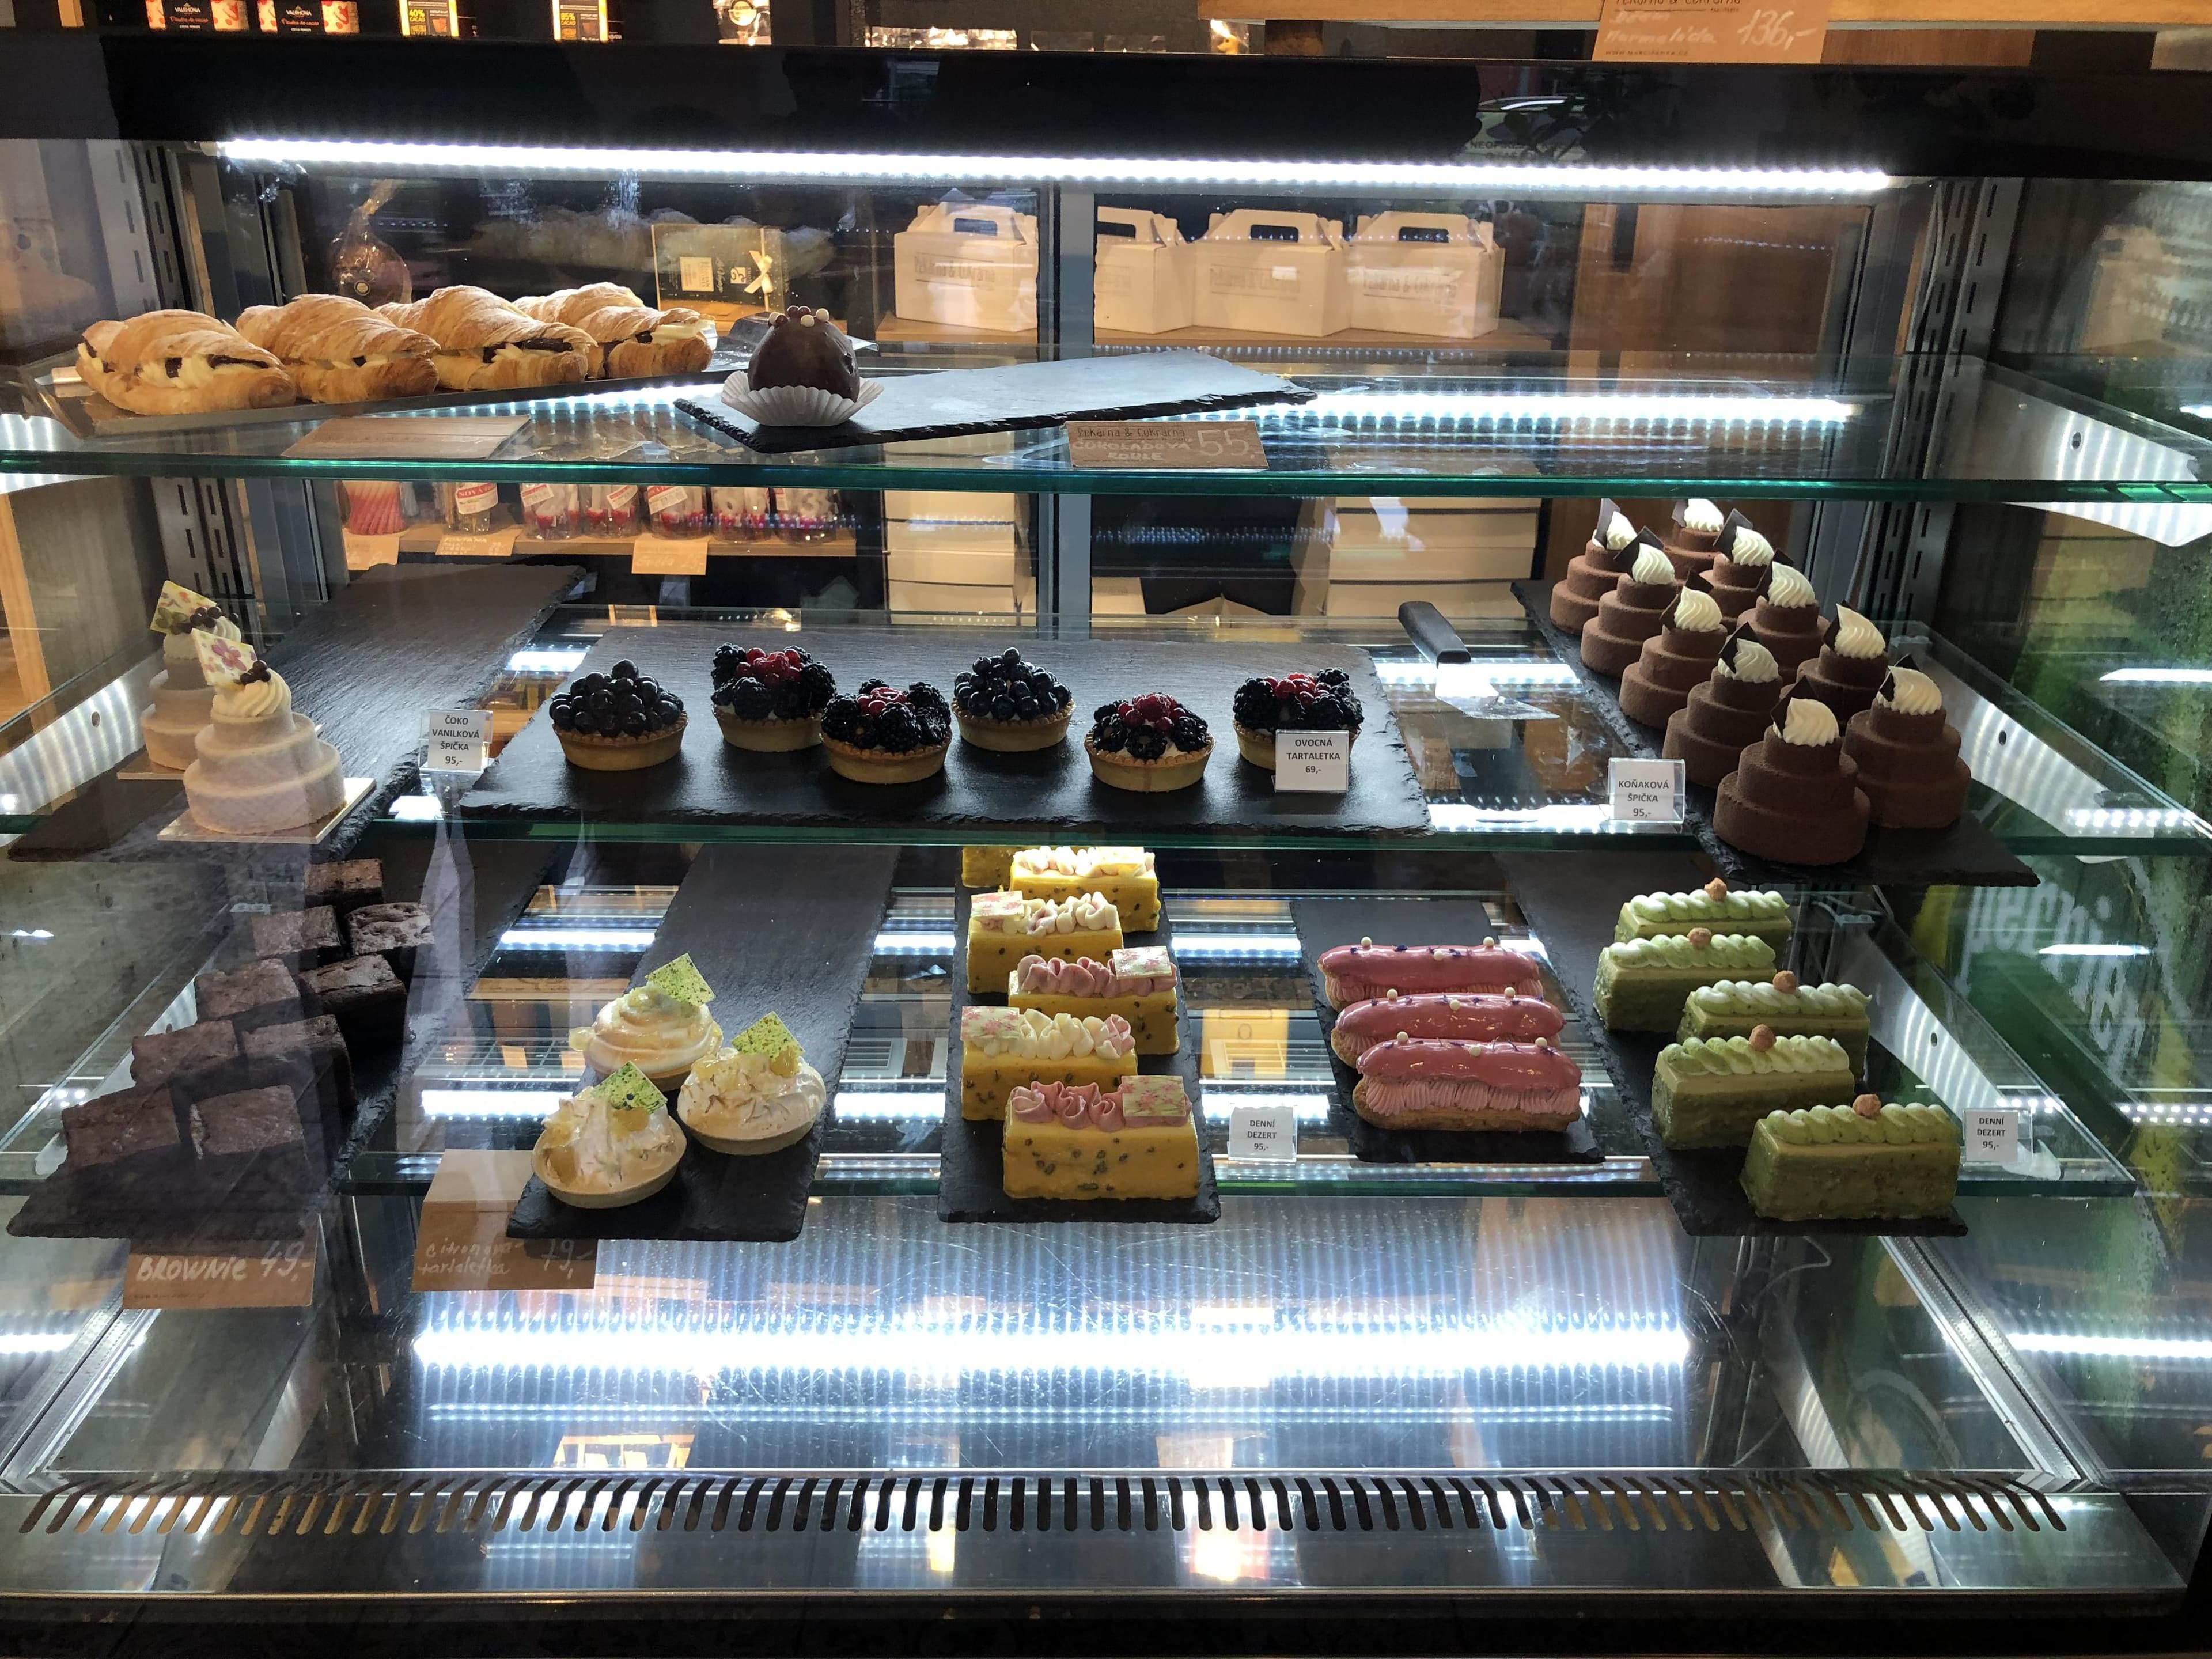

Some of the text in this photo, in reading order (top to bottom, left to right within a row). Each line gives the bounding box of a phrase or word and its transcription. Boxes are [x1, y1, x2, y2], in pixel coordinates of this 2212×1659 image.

[1737, 9, 1817, 51] 136,-
[1124, 428, 1132, 437] &
[445, 714, 469, 725] ČOKO
[432, 729, 480, 738] VANILKOVÁ
[440, 741, 469, 751] ŠPIČKA
[1295, 737, 1332, 747] OVOCNÁ
[445, 756, 463, 766] 95,-
[1305, 766, 1321, 774] 69,-
[1619, 779, 1669, 789] KOŇAKOVÁ
[1627, 793, 1658, 802] ŠPIČKA
[1633, 808, 1652, 818] 95,-
[1249, 1119, 1275, 1127] DENNÍ
[1979, 1116, 2004, 1125] DENNÍ
[1247, 1131, 1277, 1139] DEZERT
[1976, 1128, 2005, 1137] DEZERT
[1254, 1143, 1268, 1152] 95,-
[1983, 1141, 1999, 1150] 95,-
